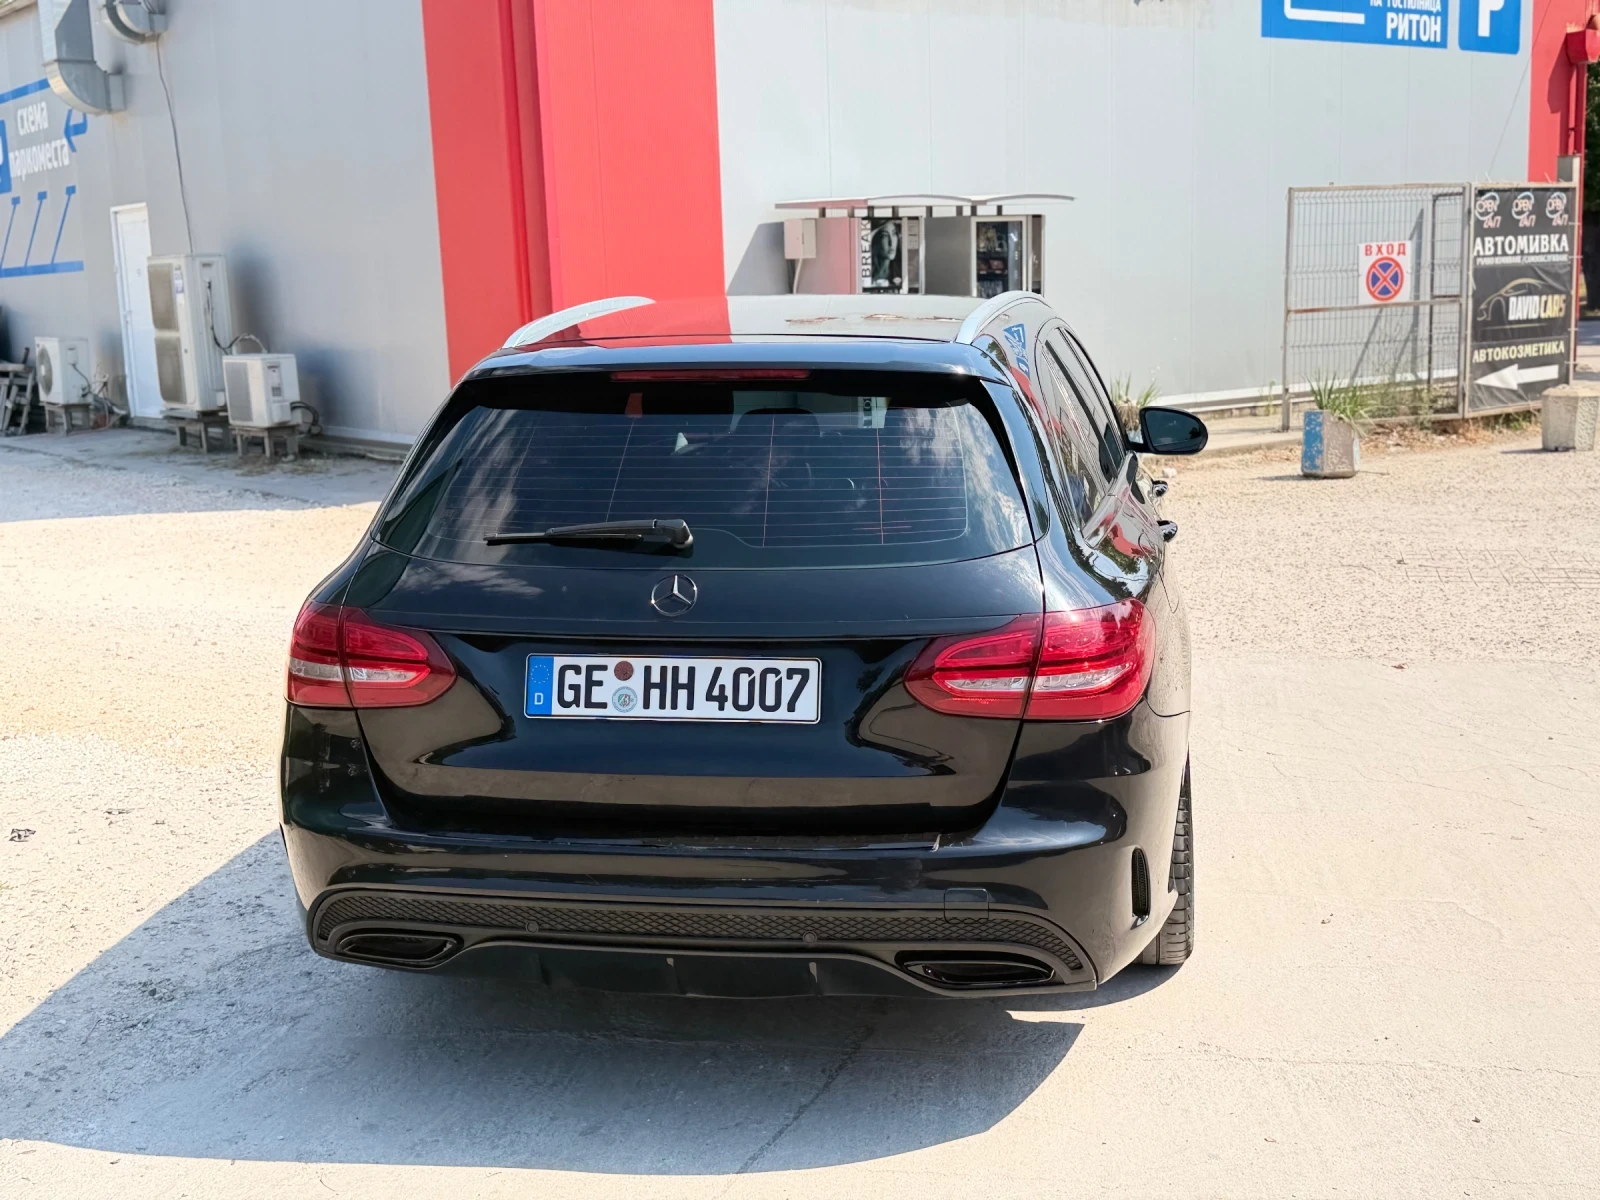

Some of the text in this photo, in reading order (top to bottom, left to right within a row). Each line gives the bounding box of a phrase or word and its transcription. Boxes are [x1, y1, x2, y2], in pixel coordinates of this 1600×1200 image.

[1386, 12, 1441, 42] РИТОН
[17, 101, 49, 136] схема
[861, 220, 871, 278] BREAK
[1364, 243, 1406, 256] ВХОД
[1474, 234, 1569, 256] АВТОМИВКА
[1508, 294, 1566, 321] DAVID CARS
[1472, 340, 1565, 363] АВТОКОЗМЕТИКА
[534, 692, 544, 705] D
[557, 664, 608, 709] GE
[643, 665, 696, 711] HH
[705, 666, 810, 712] 4007
